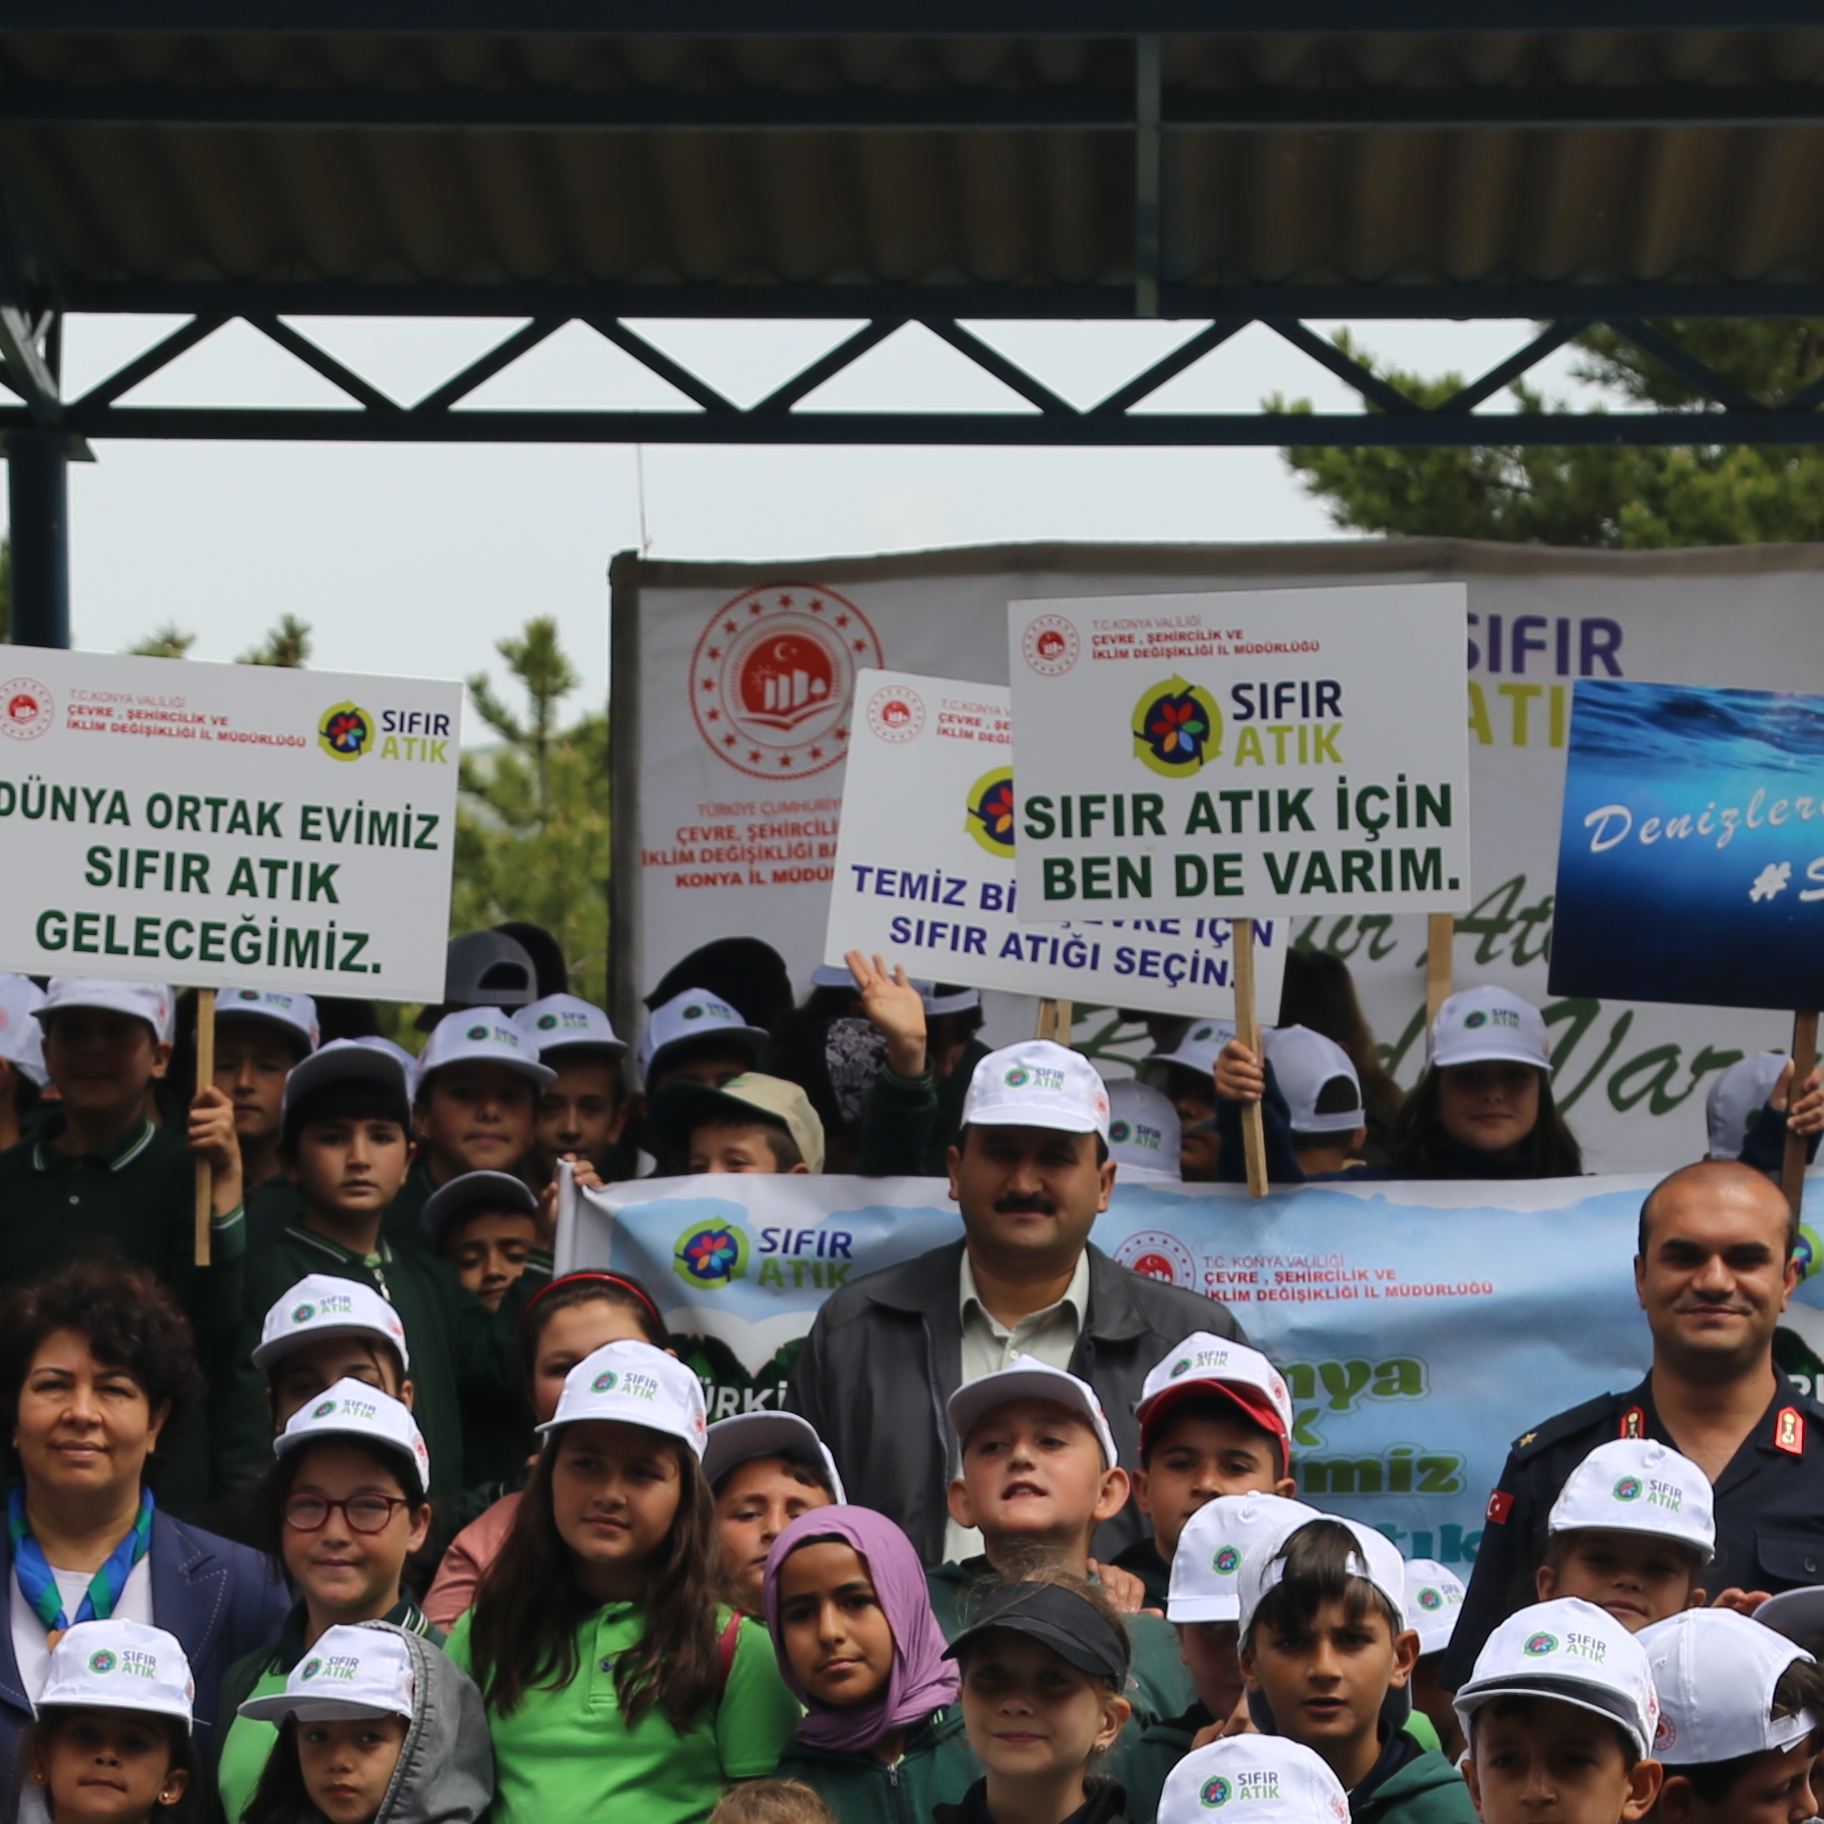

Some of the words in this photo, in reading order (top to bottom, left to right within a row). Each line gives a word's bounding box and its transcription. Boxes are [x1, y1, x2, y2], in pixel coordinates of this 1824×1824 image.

[1226, 629, 1243, 640] VE
[1231, 679, 1342, 720] SIFIR
[381, 709, 450, 736] SIFIR
[380, 736, 448, 764] ATIK
[1233, 722, 1343, 766] ATIK
[1024, 792, 1167, 839] SIFIR
[1185, 787, 1315, 834] ATIK
[1336, 773, 1451, 842] İÇİN
[145, 791, 284, 837] ORTAK
[300, 799, 439, 850] EVİMİZ
[85, 844, 210, 894] SIFIR
[227, 855, 341, 903] ATIK
[675, 869, 743, 888] KONYA
[1043, 855, 1152, 900] BEN
[1175, 853, 1245, 897] DE
[1263, 847, 1460, 894] VARIM.
[850, 863, 967, 907] TEMİZ
[979, 878, 1016, 914] Bİ
[36, 908, 381, 974] GELECEĞİMİZ.
[889, 914, 989, 958] SIFIR
[1000, 932, 1098, 973] ATIĞI
[758, 1227, 853, 1259] SIFIR
[757, 1257, 851, 1289] ATIK
[1203, 1271, 1258, 1285] ÇEVRE
[1274, 1269, 1367, 1284] ŞEHİRCİLİK
[1374, 1268, 1396, 1280] VE
[1203, 1288, 1252, 1302] İKLİM
[1256, 1285, 1358, 1303] DEĞİŞİKLİĞİ
[1364, 1284, 1380, 1298] İL
[1385, 1282, 1493, 1297] MÜDÜRLÜĞÜ
[627, 1372, 658, 1389] SIFIR
[623, 1383, 656, 1400] ATIK
[1649, 1479, 1682, 1499] SIFIR
[1647, 1492, 1680, 1511] ATIK
[1567, 1633, 1606, 1652] SIFIR
[124, 1650, 157, 1667] SIFIR
[329, 1656, 359, 1667] SIFIR
[1566, 1644, 1604, 1664] ATIK
[123, 1662, 156, 1679] ATIK
[326, 1666, 355, 1679] ATIK
[1238, 1771, 1278, 1786] SIFIR
[1240, 1784, 1280, 1799] ATIK
